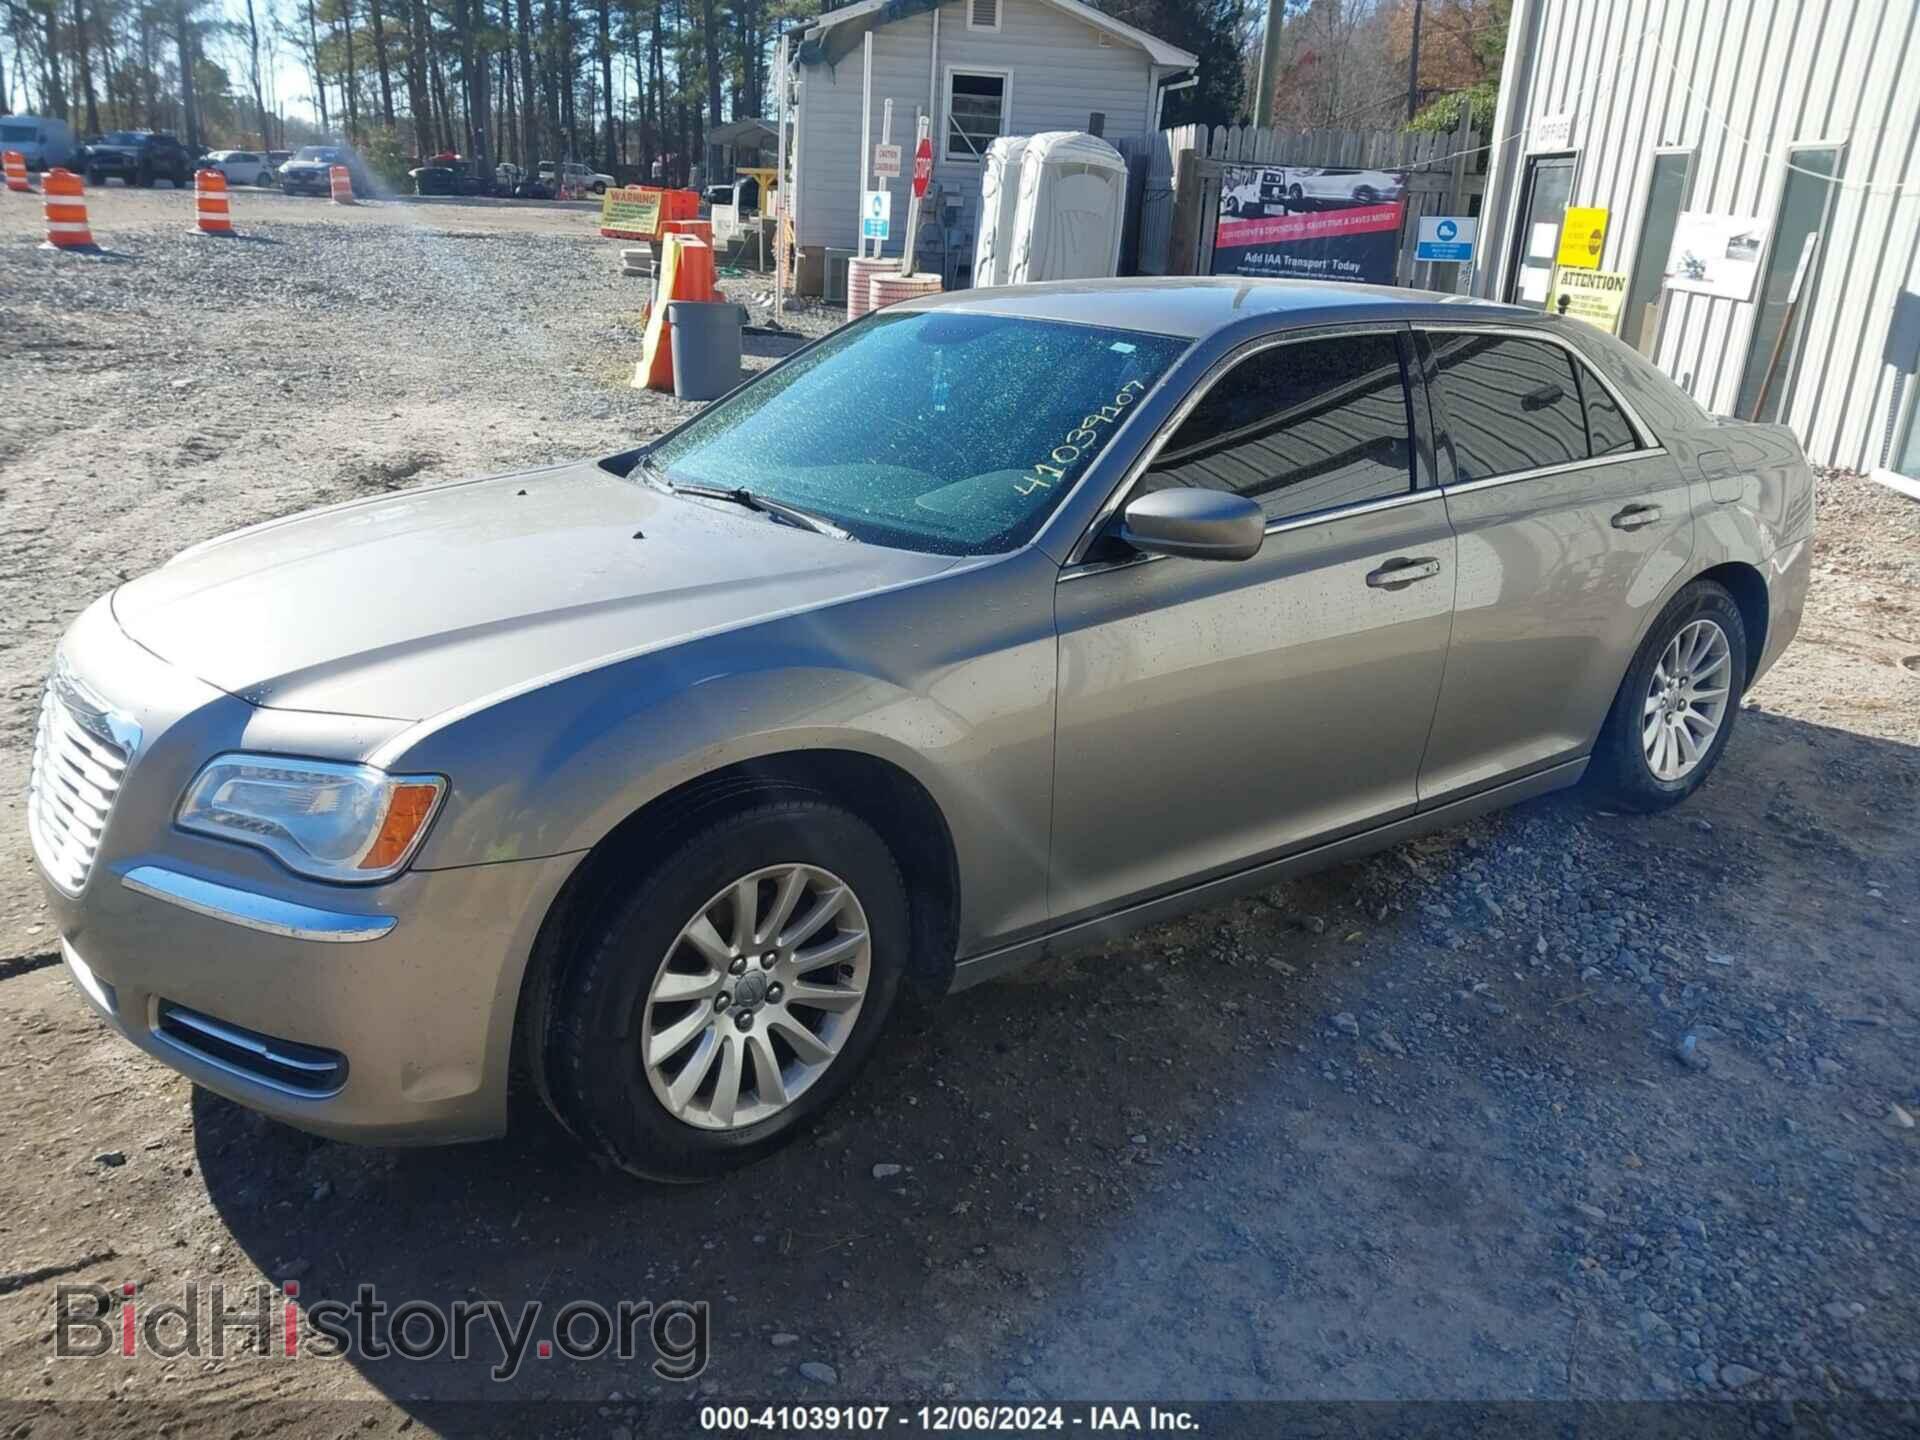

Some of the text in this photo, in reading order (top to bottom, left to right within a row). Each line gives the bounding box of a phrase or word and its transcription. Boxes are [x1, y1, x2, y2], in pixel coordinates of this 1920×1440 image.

[914, 158, 932, 178] STOP
[611, 191, 656, 204] WARNING
[1244, 252, 1263, 263] Add
[1264, 254, 1281, 265] IAA
[1333, 259, 1360, 273] Today
[1561, 271, 1625, 291] ATTENTION
[1013, 380, 1145, 496] 41039107
